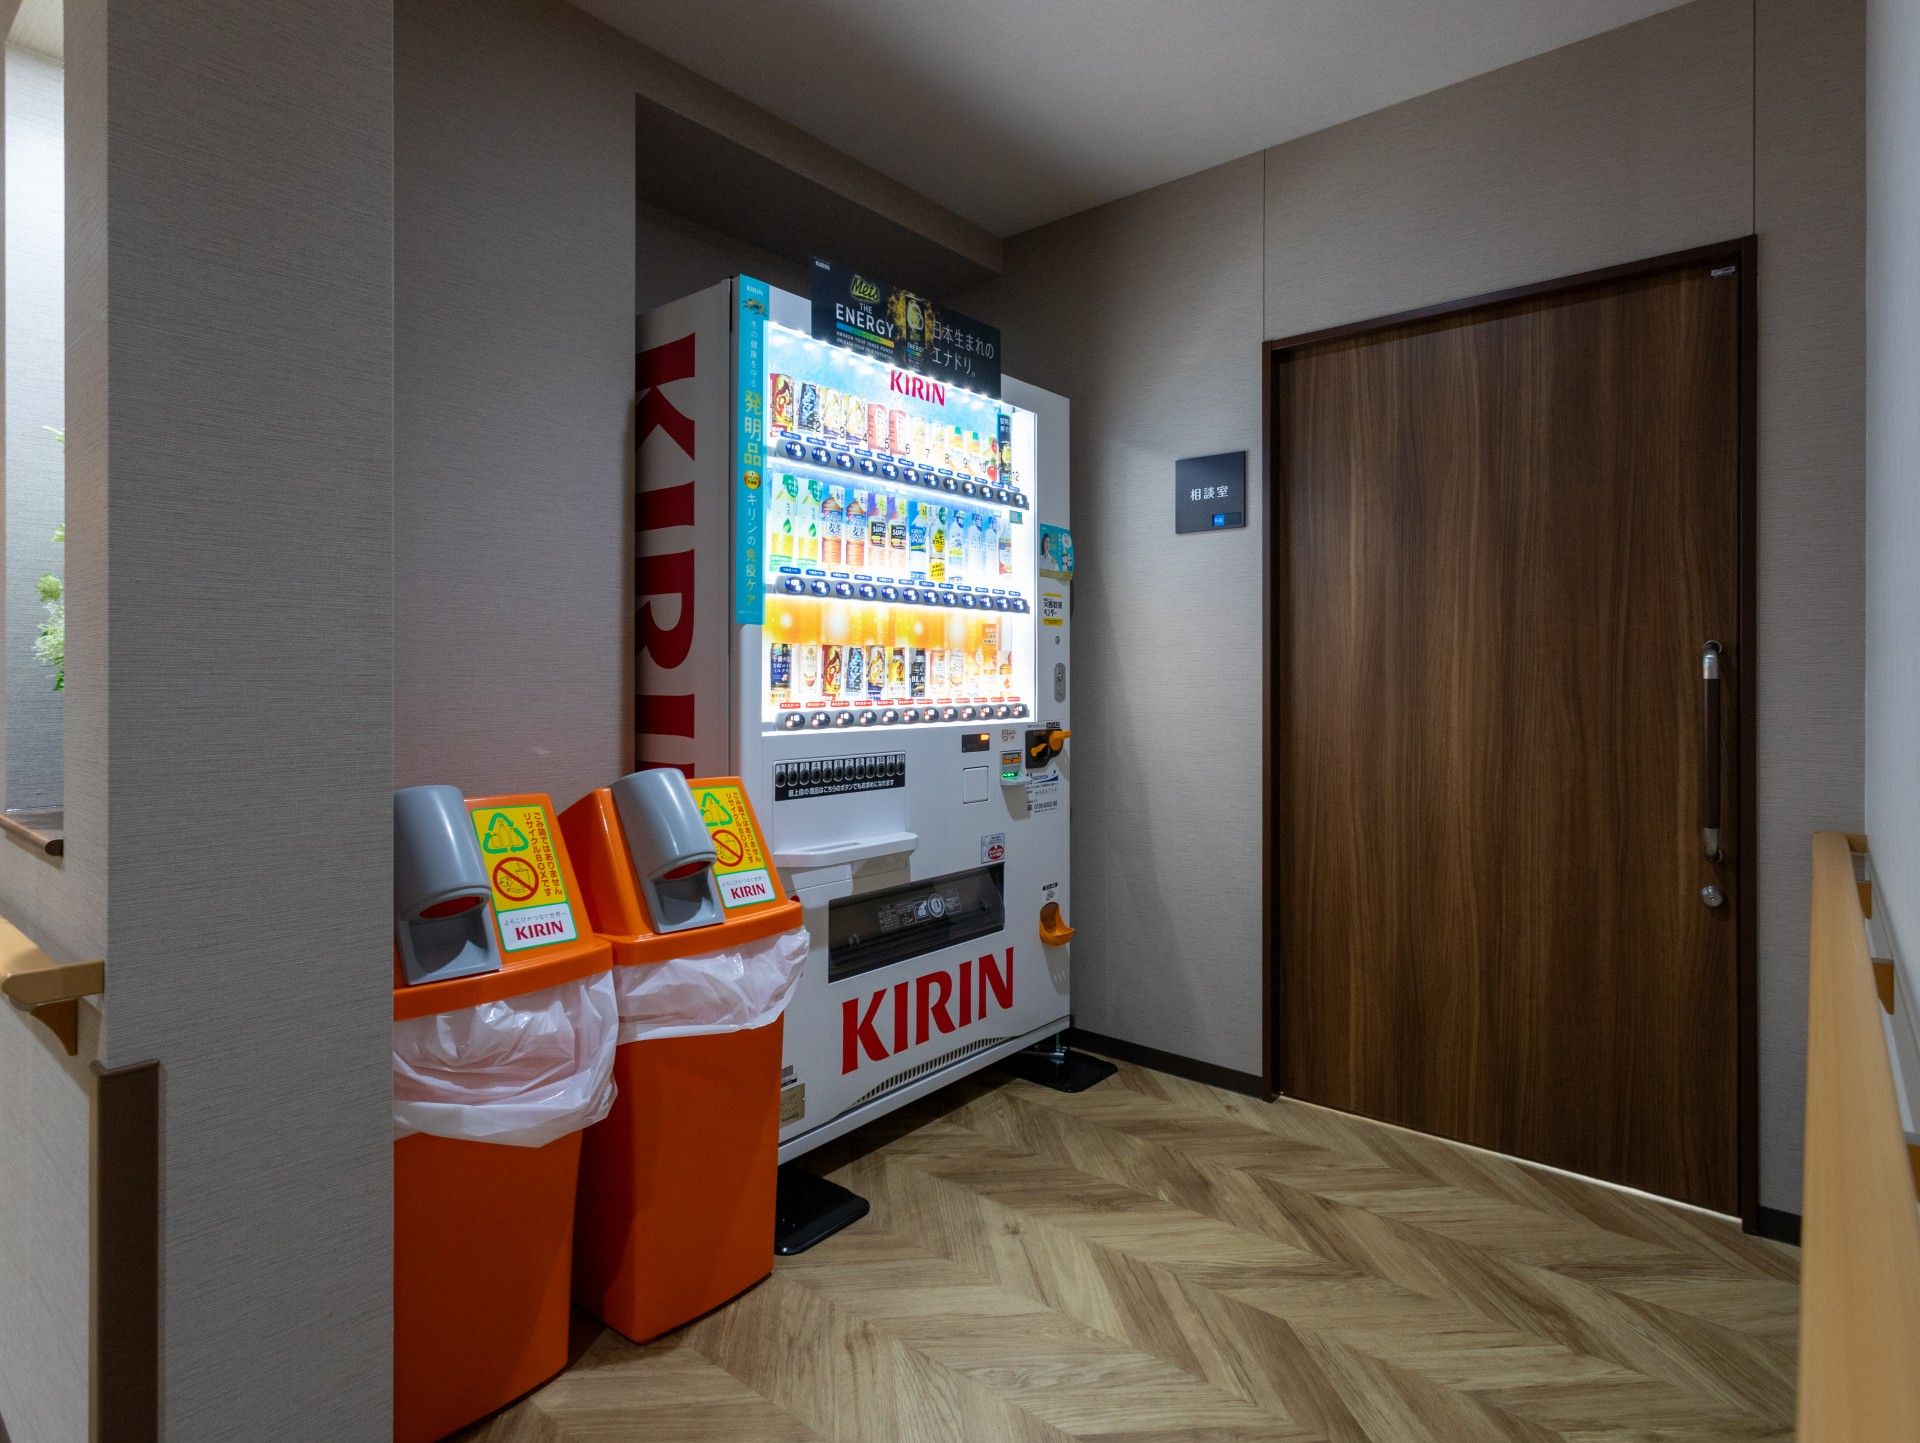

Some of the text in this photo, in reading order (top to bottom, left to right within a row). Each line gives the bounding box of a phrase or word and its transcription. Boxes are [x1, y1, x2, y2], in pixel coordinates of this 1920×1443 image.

[852, 278, 880, 300] Mets
[836, 303, 895, 338] ENERGY
[860, 303, 873, 314] THE
[933, 321, 995, 359] 日本生まれの
[890, 369, 946, 407] KIRIN
[744, 391, 762, 468] 発明品
[1190, 485, 1229, 501] 相談室
[636, 332, 695, 780] KIRI
[524, 813, 551, 897] リサイクルBOXです
[534, 812, 562, 895] ごみ箱ではありません
[731, 884, 766, 899] KIRIN
[515, 920, 564, 940] KIRIN
[842, 946, 1015, 1076] KIRIN
